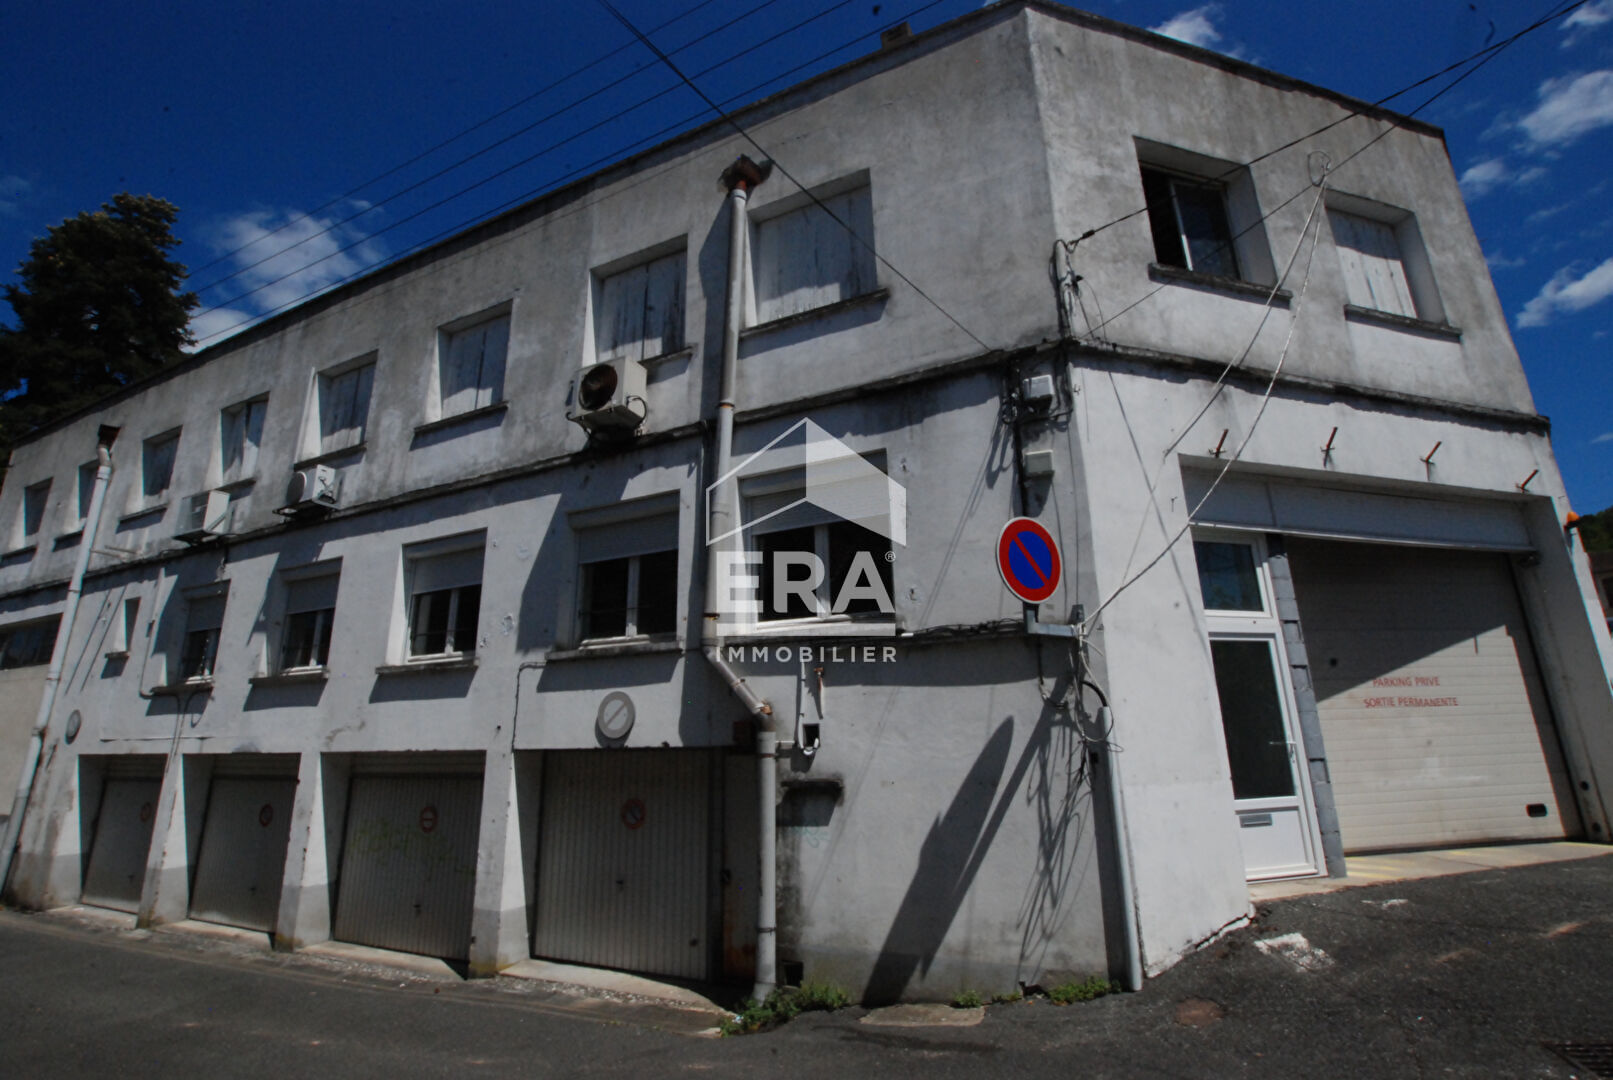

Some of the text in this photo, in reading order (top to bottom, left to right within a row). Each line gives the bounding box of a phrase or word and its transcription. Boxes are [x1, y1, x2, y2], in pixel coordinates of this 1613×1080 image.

[1372, 677, 1412, 687] PARKING
[1363, 697, 1459, 708] SORTIE PERMANENTE
